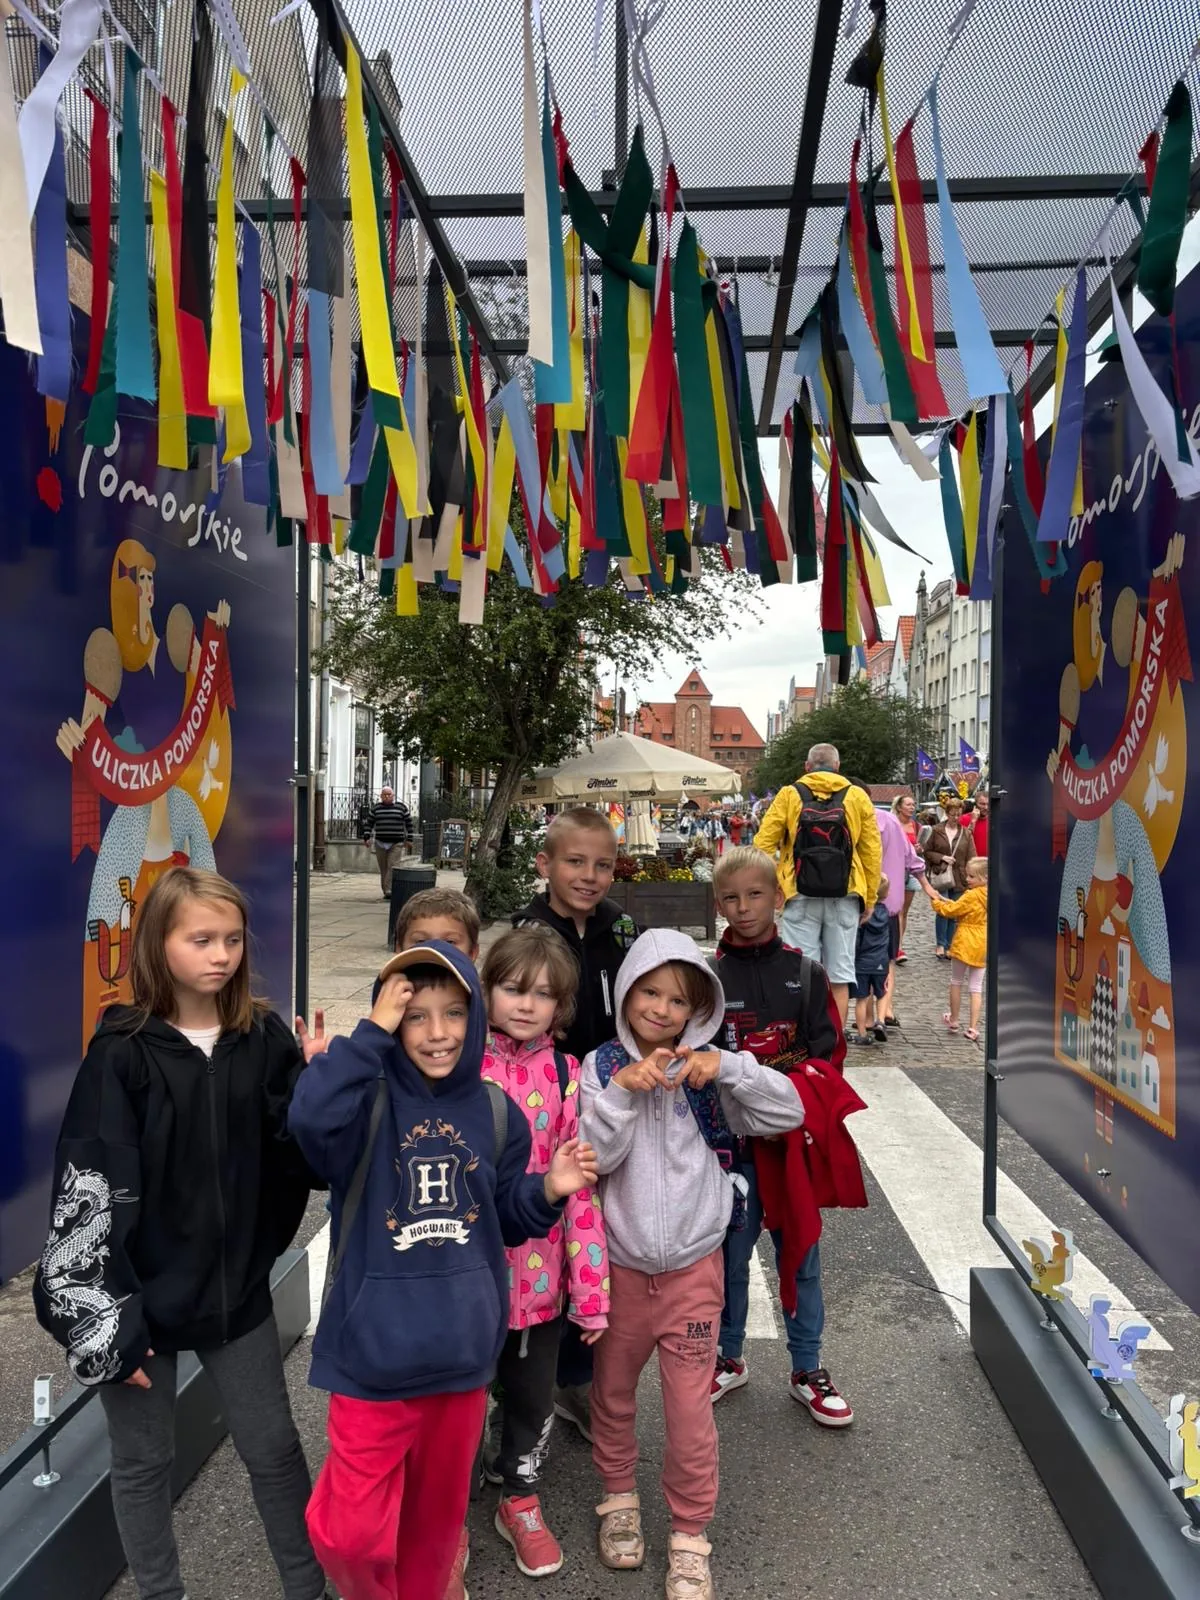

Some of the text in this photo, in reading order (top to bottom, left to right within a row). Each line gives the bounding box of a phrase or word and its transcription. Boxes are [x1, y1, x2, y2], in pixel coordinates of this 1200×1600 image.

[1062, 598, 1169, 805] ULICZKA POMORSKA
[92, 639, 220, 790] ULICZKA POMORSKA
[586, 777, 618, 789] Amber
[681, 775, 707, 787] Amber
[416, 1162, 450, 1205] H
[409, 1223, 458, 1238] HOGWARTS
[687, 1320, 713, 1333] PAW
[686, 1331, 713, 1339] PATROL
